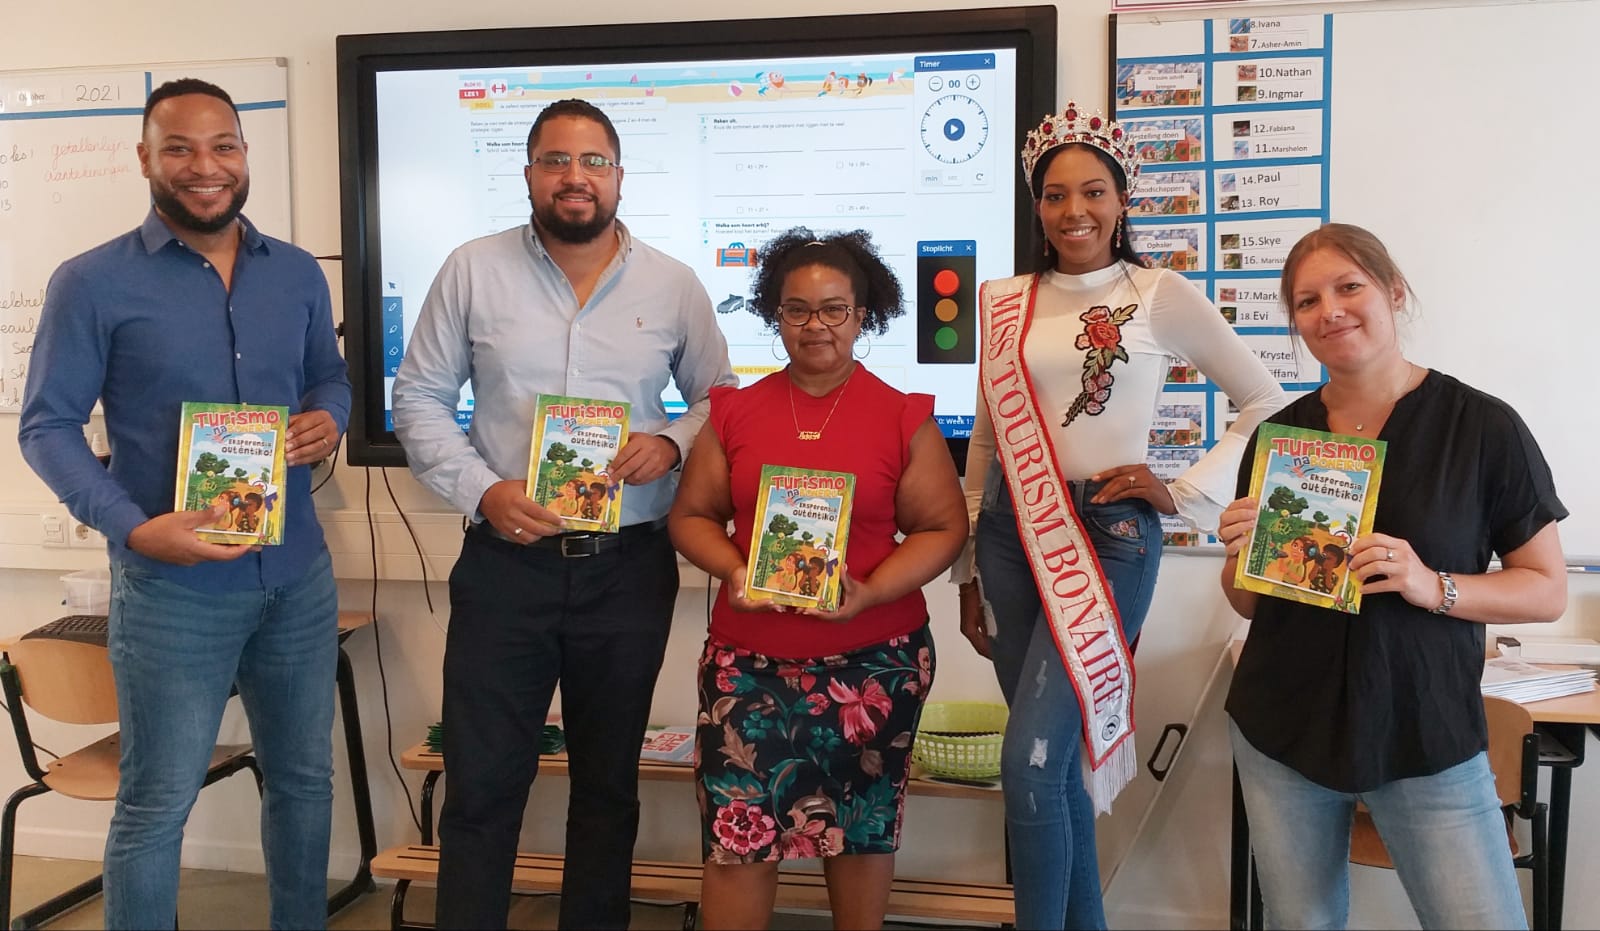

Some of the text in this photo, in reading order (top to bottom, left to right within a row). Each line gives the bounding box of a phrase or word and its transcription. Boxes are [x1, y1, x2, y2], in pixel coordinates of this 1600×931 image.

[948, 79, 961, 88] 00
[75, 84, 121, 102] 2021
[1259, 196, 1280, 207] Roy
[922, 244, 953, 253] Stoplicht
[1253, 310, 1269, 321] Evi
[1260, 350, 1294, 361] Krystel
[546, 404, 625, 420] Turismo
[193, 410, 280, 428] Turismo
[564, 417, 577, 427] na
[946, 417, 965, 425] Week
[213, 425, 227, 437] na
[1270, 437, 1377, 462] Turismo
[1292, 456, 1310, 468] na
[771, 475, 847, 491] Turismo
[1310, 473, 1363, 491] Eksperensia
[787, 488, 799, 498] na
[988, 289, 1123, 715] MISS TOURISM BONAIRE
